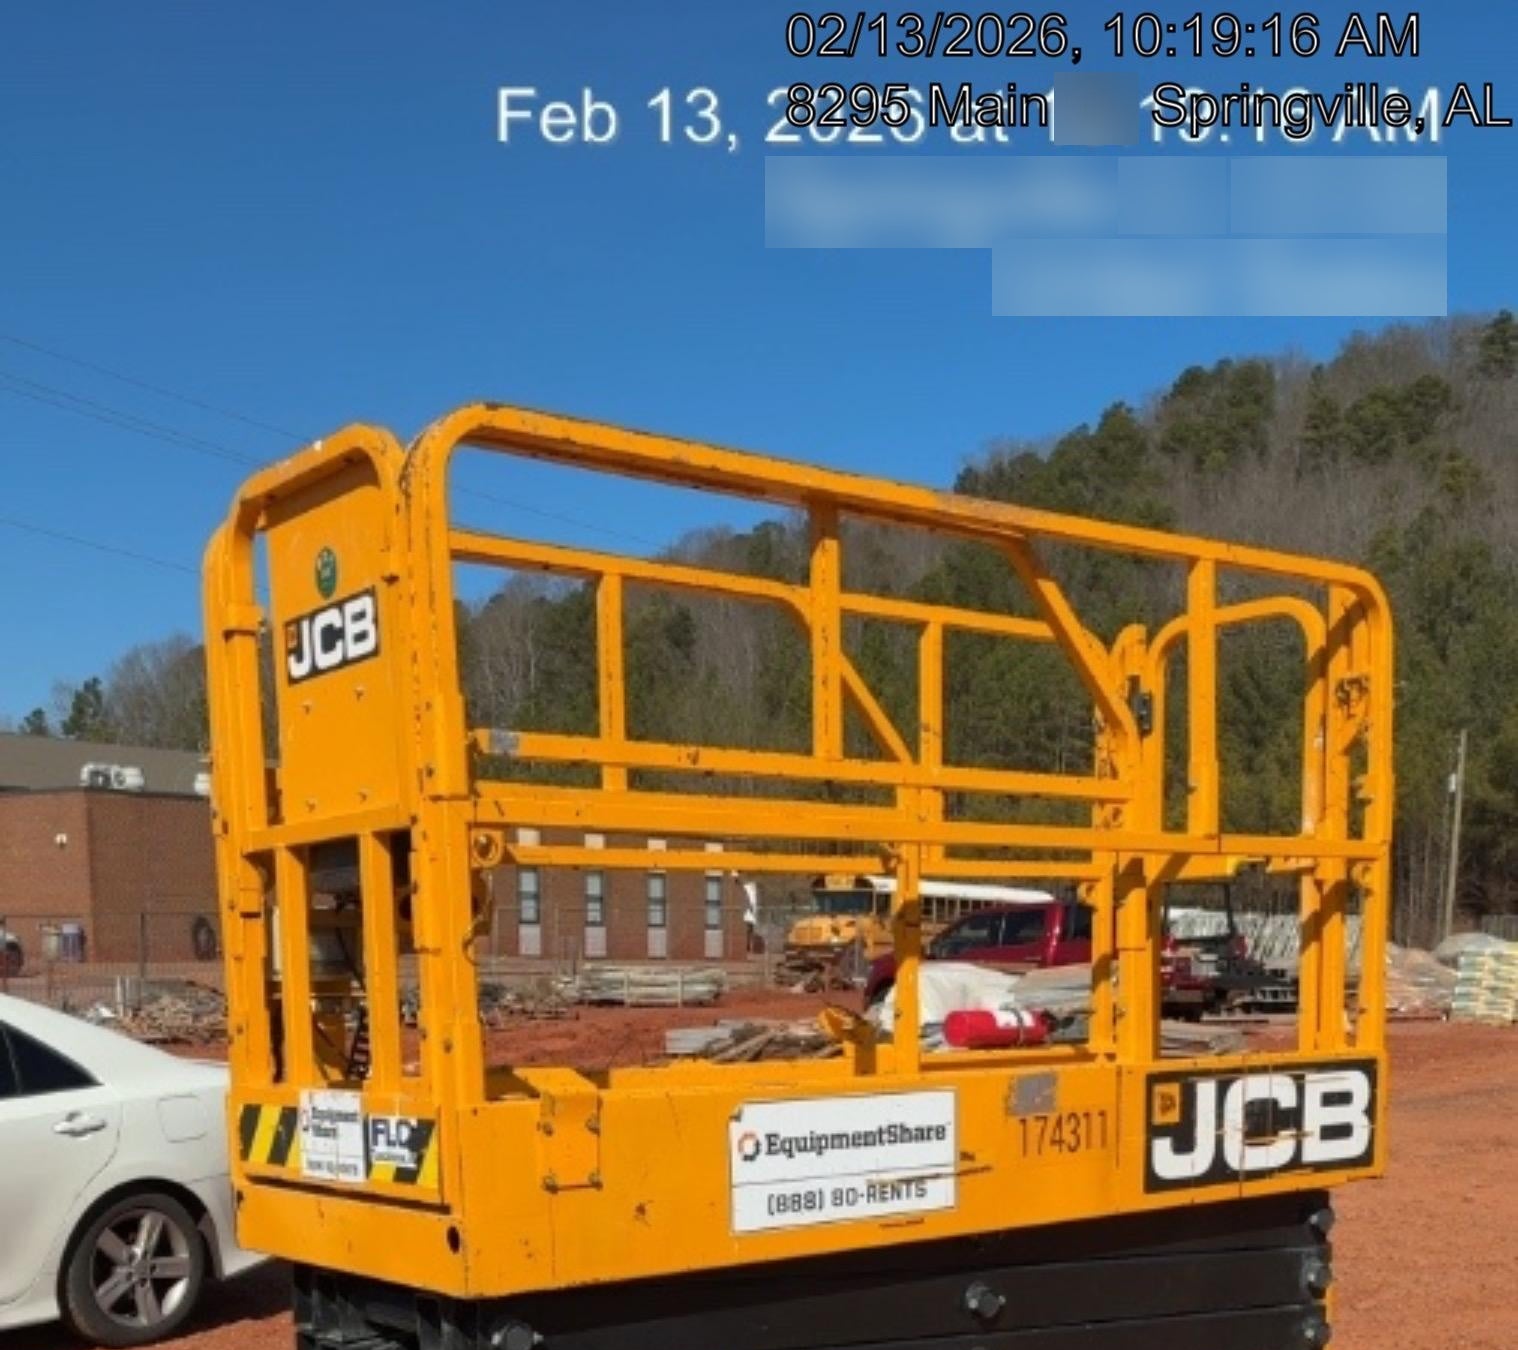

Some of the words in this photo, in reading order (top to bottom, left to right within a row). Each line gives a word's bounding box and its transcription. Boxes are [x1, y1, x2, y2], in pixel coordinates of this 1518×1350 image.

[287, 595, 378, 679] JCB
[764, 1122, 947, 1159] EquipmentShare
[1017, 1110, 1109, 1159] 174311
[1150, 1069, 1371, 1180] JCB
[767, 1187, 824, 1216] (888)
